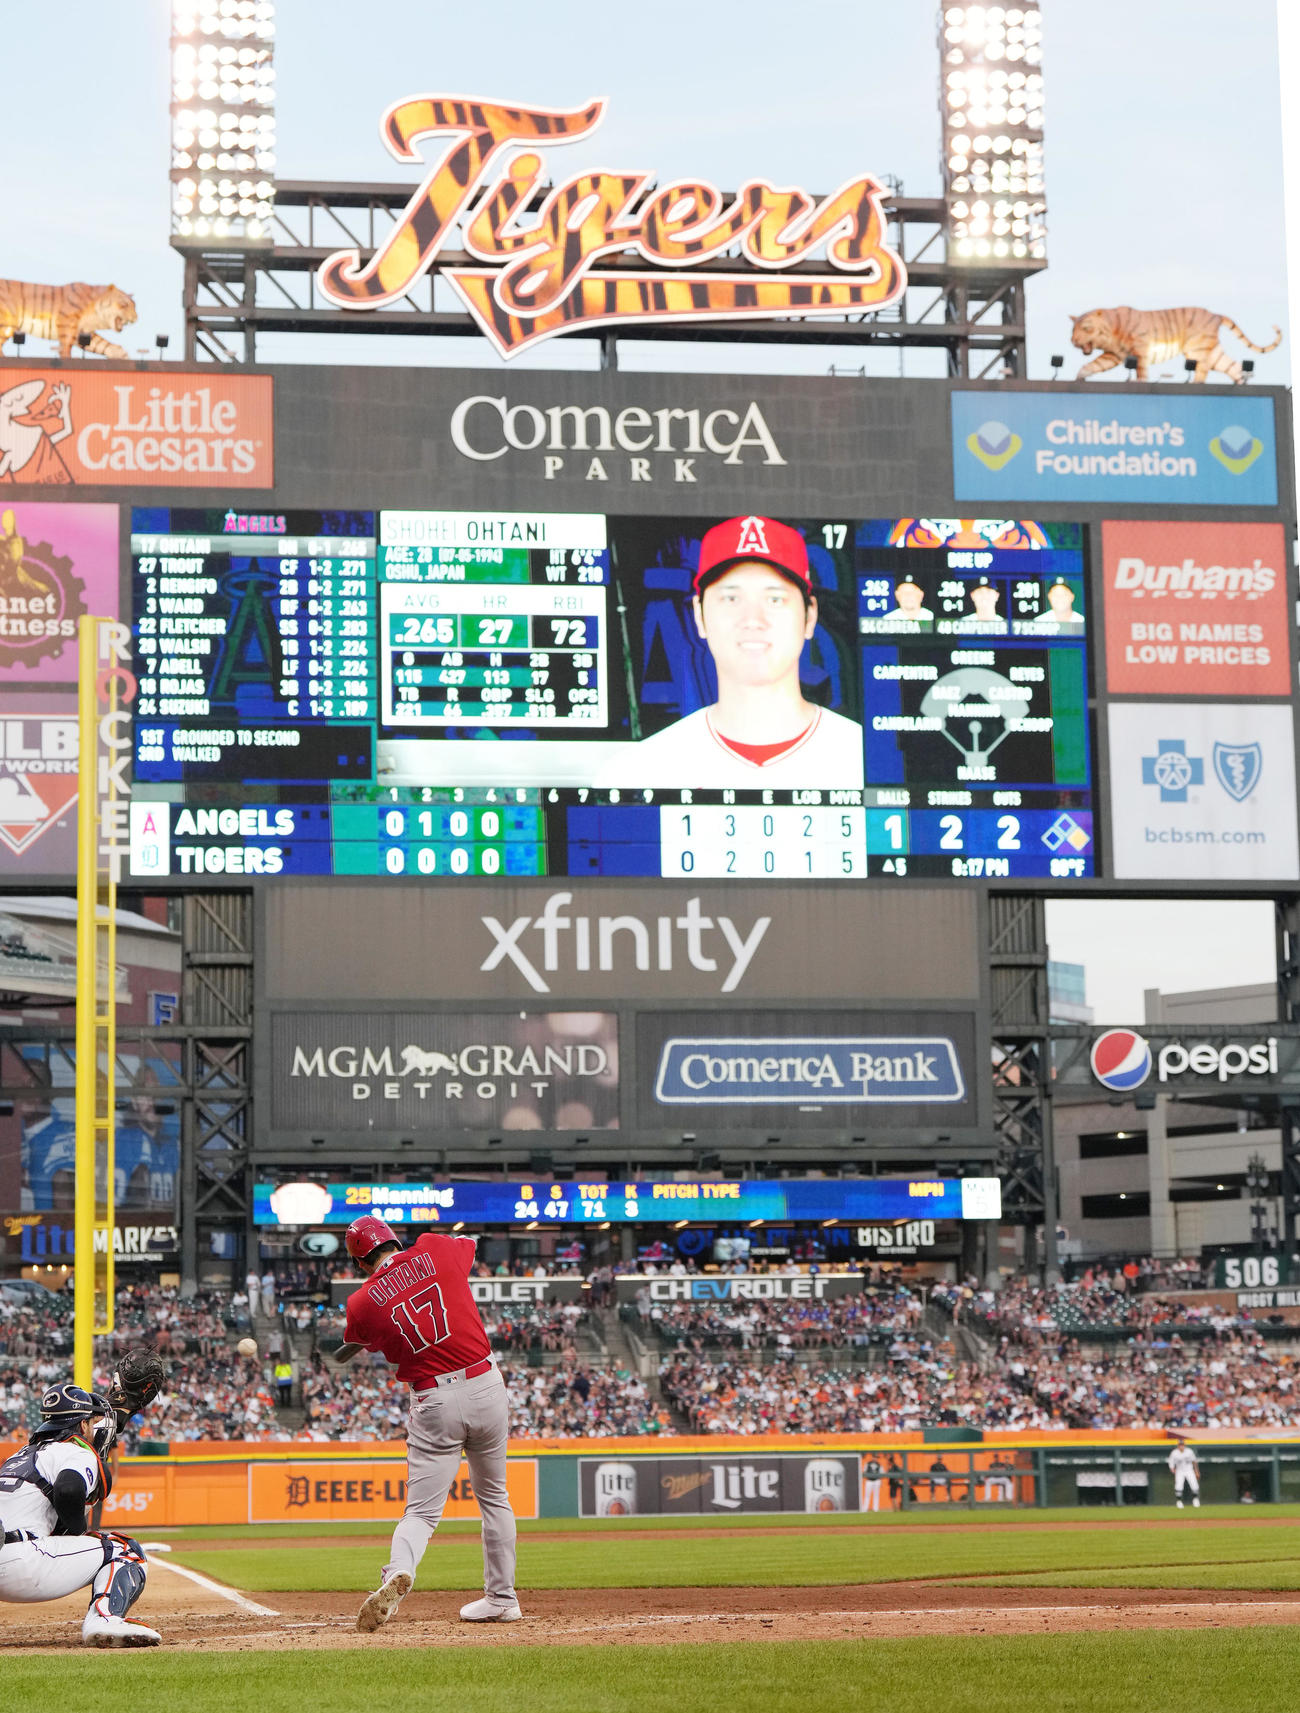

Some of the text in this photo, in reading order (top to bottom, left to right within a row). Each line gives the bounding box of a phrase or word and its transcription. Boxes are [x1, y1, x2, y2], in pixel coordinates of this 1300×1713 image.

[318, 92, 908, 355] Tigers
[113, 385, 237, 435] Little
[1046, 419, 1184, 447] Children's
[76, 422, 257, 474] Caesars
[544, 456, 698, 483] PARK
[1035, 450, 1197, 477] Foundation
[223, 513, 287, 534] ANGELS
[467, 521, 546, 542] OHTANI
[822, 524, 848, 550] 17
[139, 557, 156, 573] 27
[160, 557, 204, 573] TROUT
[280, 558, 299, 574] CF
[310, 559, 332, 574] 1-2
[425, 565, 466, 582] JAPAN
[545, 566, 567, 583] WT
[1114, 557, 1276, 592] Dunham's
[147, 577, 156, 593] 2
[147, 597, 156, 613] 3
[404, 594, 584, 611] AVG HR RBI
[139, 617, 156, 633] 22
[395, 618, 455, 644] .265
[478, 618, 514, 645] 27
[550, 619, 588, 646] 72
[1131, 622, 1264, 643] BIG NAMES
[310, 640, 332, 655] 1-2
[1126, 645, 1271, 666] LOW PRICES
[147, 658, 156, 674] 7
[288, 699, 299, 715] C
[310, 700, 332, 715] 1-2
[0, 720, 79, 760] LB
[172, 730, 300, 746] GROUNDED TO SECOND
[96, 622, 138, 883] ROCKET
[172, 746, 221, 762] WALKED
[389, 787, 862, 805] 1 2 3 4 5 6 7 8 9 R H E LOB MVR
[877, 790, 911, 806] BALLS
[175, 808, 852, 838] ANGELS 0 1 0 0 1 3 0 2 5
[884, 814, 1021, 851] 1 2 2
[1145, 826, 1267, 845] bcbsm.com
[175, 846, 853, 875] TIGERS 0 0 0 0 0 2 0 1 5
[480, 892, 772, 993] xfinity
[291, 1044, 606, 1078] MGM GRAND
[850, 1051, 939, 1083] Bank
[1158, 1037, 1279, 1083] pepsi
[352, 1081, 551, 1100] DETROIT
[346, 1186, 372, 1205] 25
[372, 1186, 454, 1207] Manning
[522, 1185, 534, 1200] B
[551, 1185, 562, 1199] S
[578, 1185, 608, 1199] TOT
[625, 1184, 637, 1199] K
[653, 1184, 698, 1199] PITCH
[701, 1183, 740, 1198] TYPE
[514, 1201, 539, 1219] 24
[544, 1201, 568, 1219] 47
[581, 1201, 606, 1219] 71
[625, 1200, 639, 1218] 3
[858, 1221, 935, 1246] BISTRO
[368, 1253, 436, 1307] OHTANI
[1225, 1256, 1279, 1288] 506
[650, 1278, 829, 1300] CHEVROLET
[391, 1282, 452, 1354] 17
[601, 1473, 635, 1495] Lite
[710, 1465, 779, 1508] Lite
[811, 1469, 843, 1491] Lite
